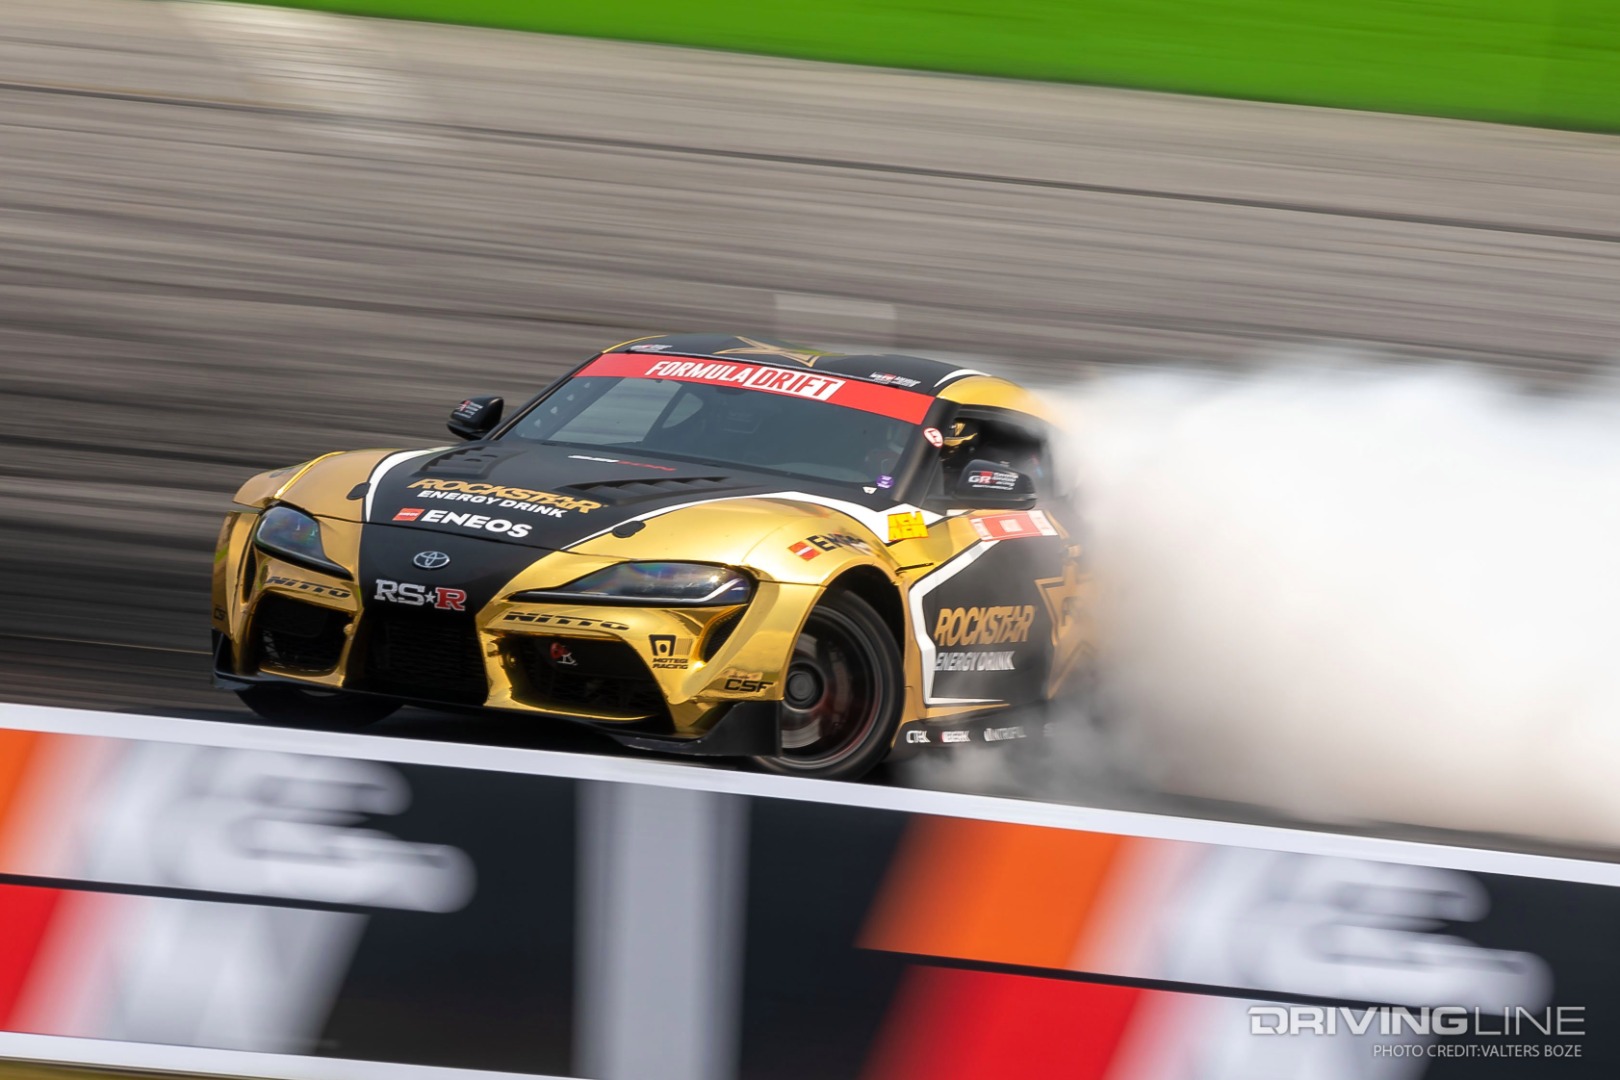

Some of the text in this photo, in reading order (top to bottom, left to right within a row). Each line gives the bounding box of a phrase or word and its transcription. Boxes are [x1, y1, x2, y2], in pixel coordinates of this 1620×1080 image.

[645, 361, 838, 398] FORMULA DRIFT
[968, 475, 992, 485] GR
[407, 478, 603, 513] ROCKSTAR
[417, 490, 568, 518] ENERGY DRINK
[420, 509, 533, 538] ENEOS
[265, 576, 352, 599] NITTO
[503, 611, 630, 631] NITTO
[934, 605, 1035, 646] ROCKSTAR
[935, 652, 979, 671] ENERGY
[724, 679, 774, 692] CSF
